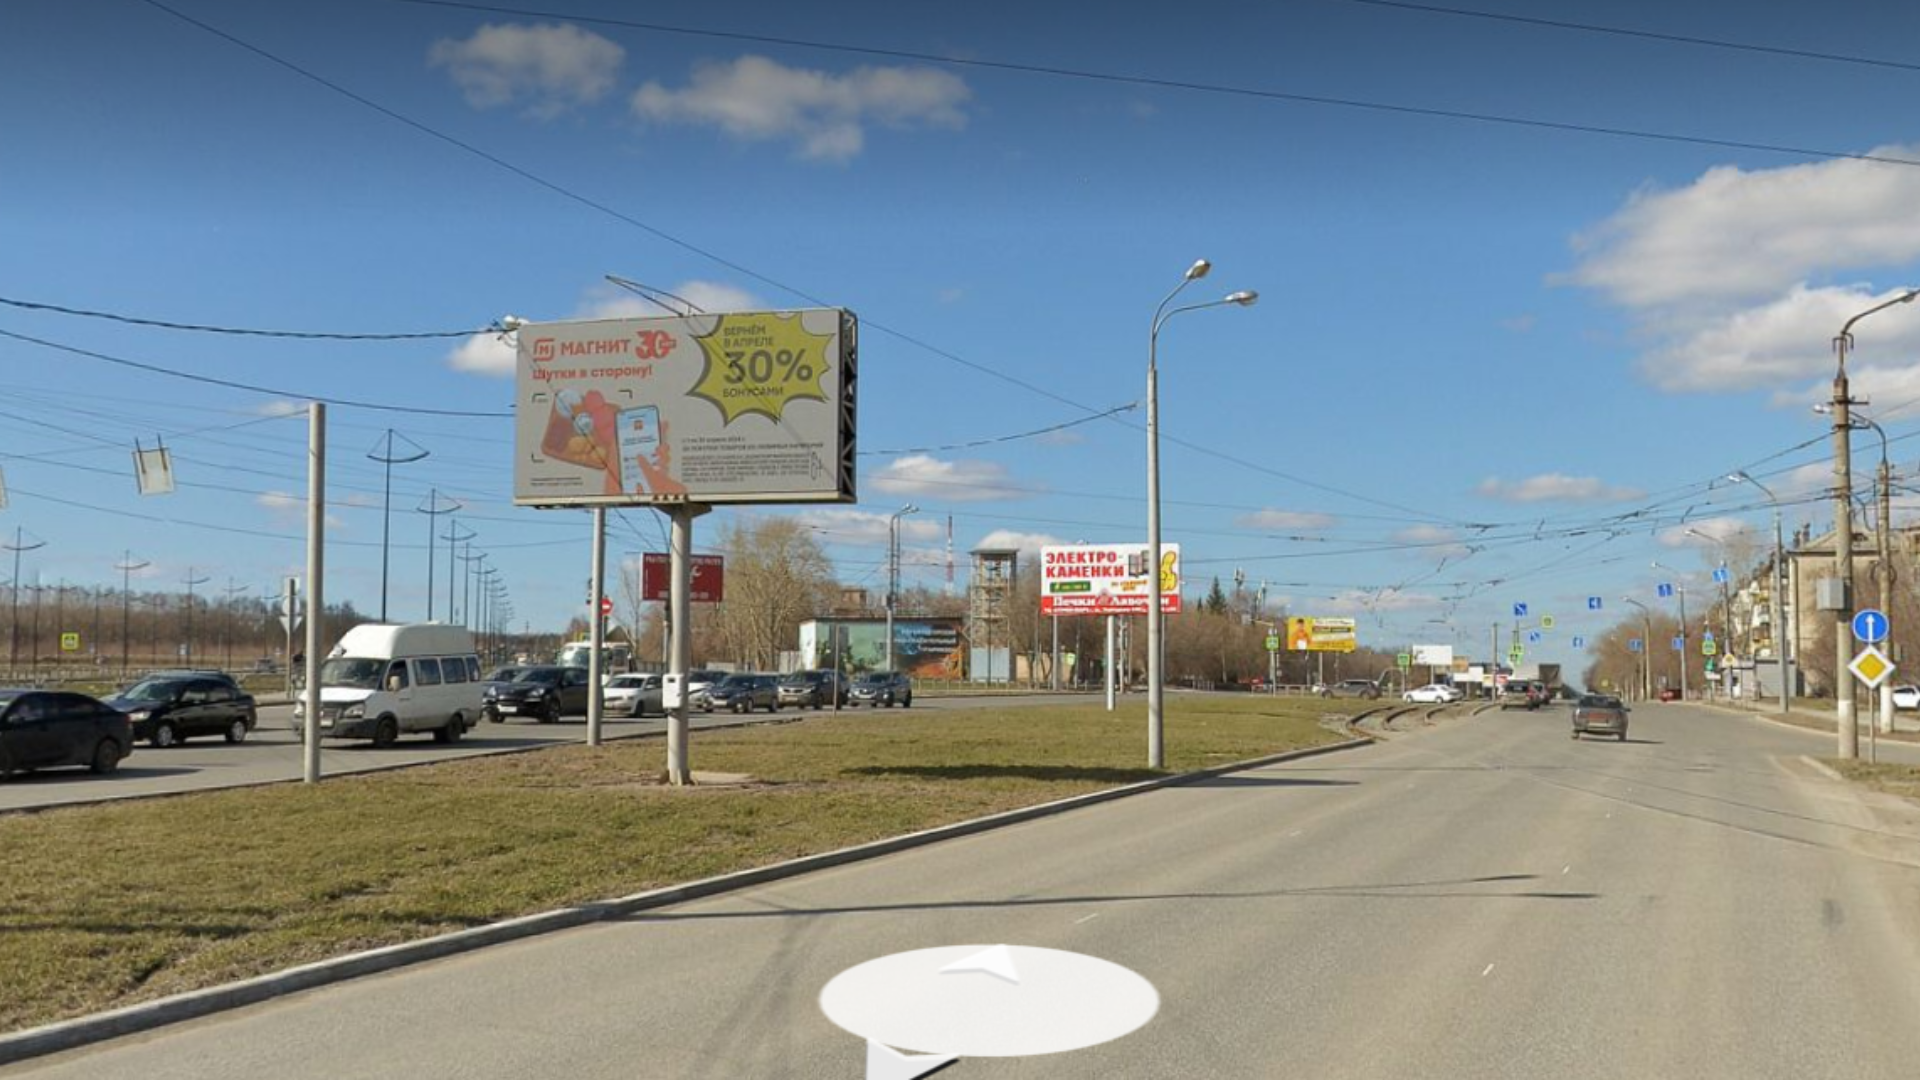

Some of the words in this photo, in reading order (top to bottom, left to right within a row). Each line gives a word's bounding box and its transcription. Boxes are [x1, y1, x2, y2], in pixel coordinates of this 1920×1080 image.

[561, 339, 631, 355] МАГНИТ
[733, 336, 773, 347] АПРЕЛЕ
[723, 348, 813, 384] 30%
[533, 367, 576, 382] Шутки
[591, 365, 653, 379] сторону!
[723, 386, 783, 398] БОНУСАМИ
[1046, 565, 1125, 578] КАМЕНКИ
[1053, 595, 1096, 606] Печки
